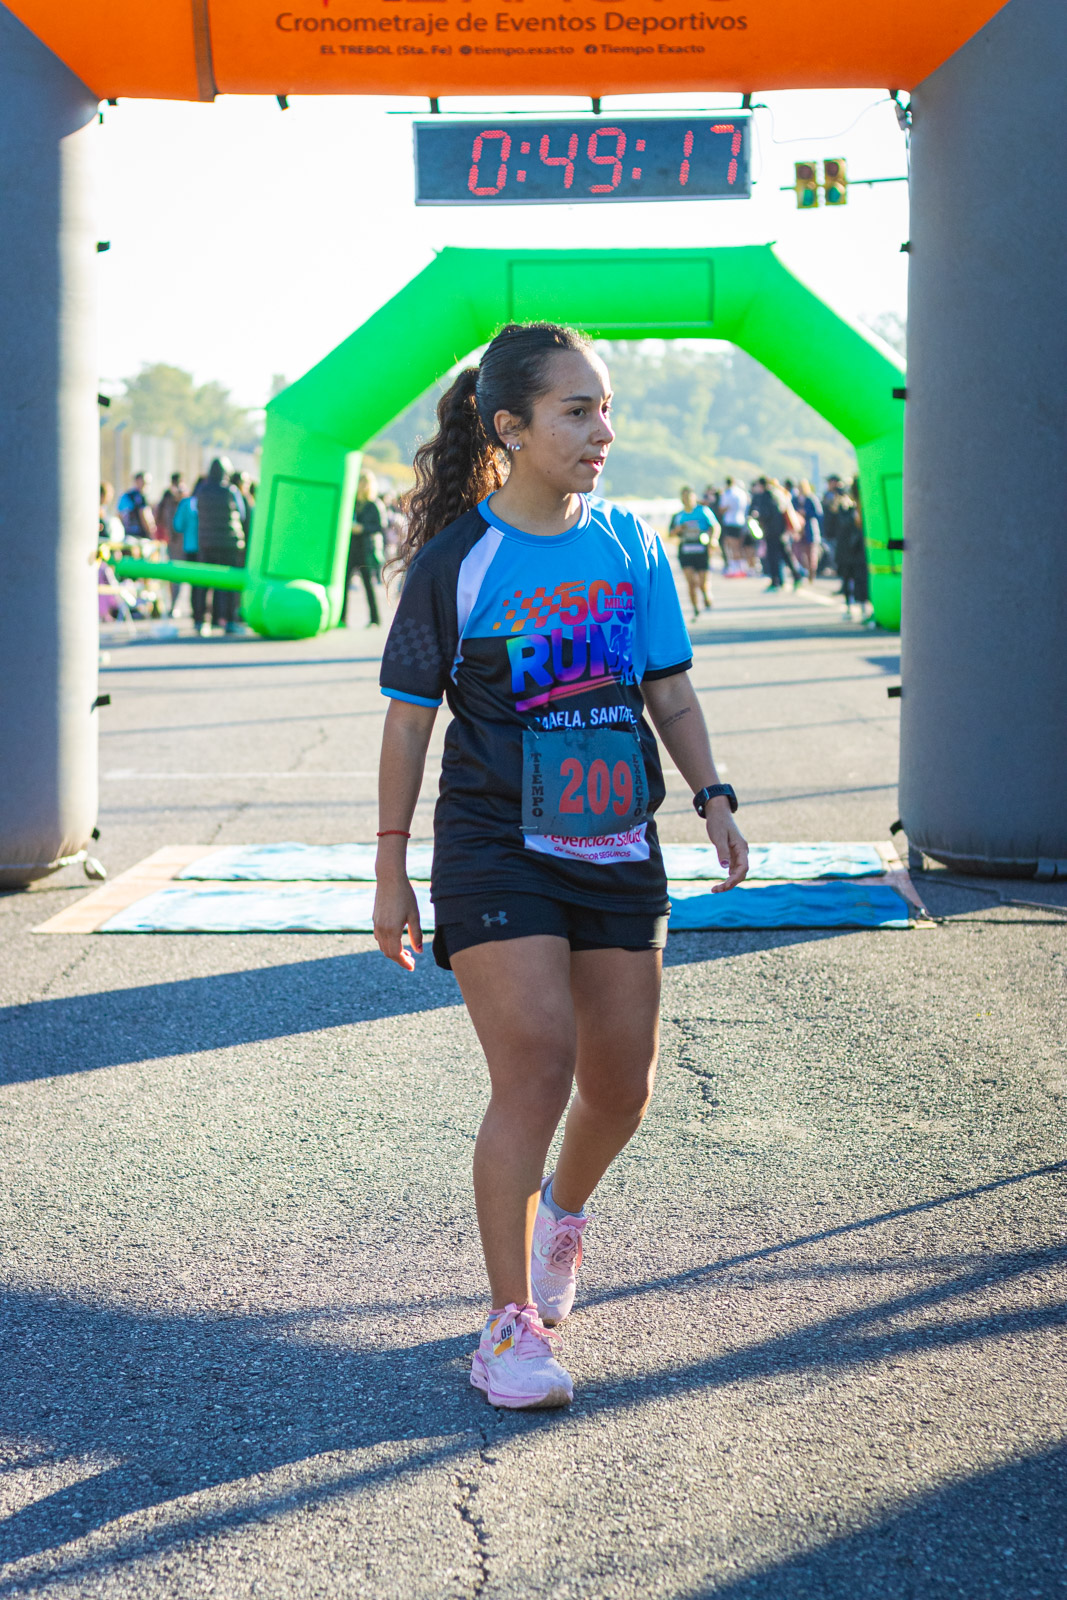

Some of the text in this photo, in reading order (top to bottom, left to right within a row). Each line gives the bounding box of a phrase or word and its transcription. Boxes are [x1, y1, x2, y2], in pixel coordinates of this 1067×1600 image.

[276, 11, 748, 36] Cronometraje de Eventos Deportivos
[321, 45, 336, 55] EL
[340, 45, 393, 55] TREBOL
[600, 44, 655, 56] Tiempo
[657, 43, 706, 55] Exacto
[468, 124, 741, 196] 0:49:17
[559, 580, 634, 626] 500
[604, 597, 635, 610] MILLA
[531, 752, 544, 818] TIEMPO
[558, 757, 633, 816] 209
[631, 753, 644, 817] EXACTO
[543, 833, 616, 849] evención
